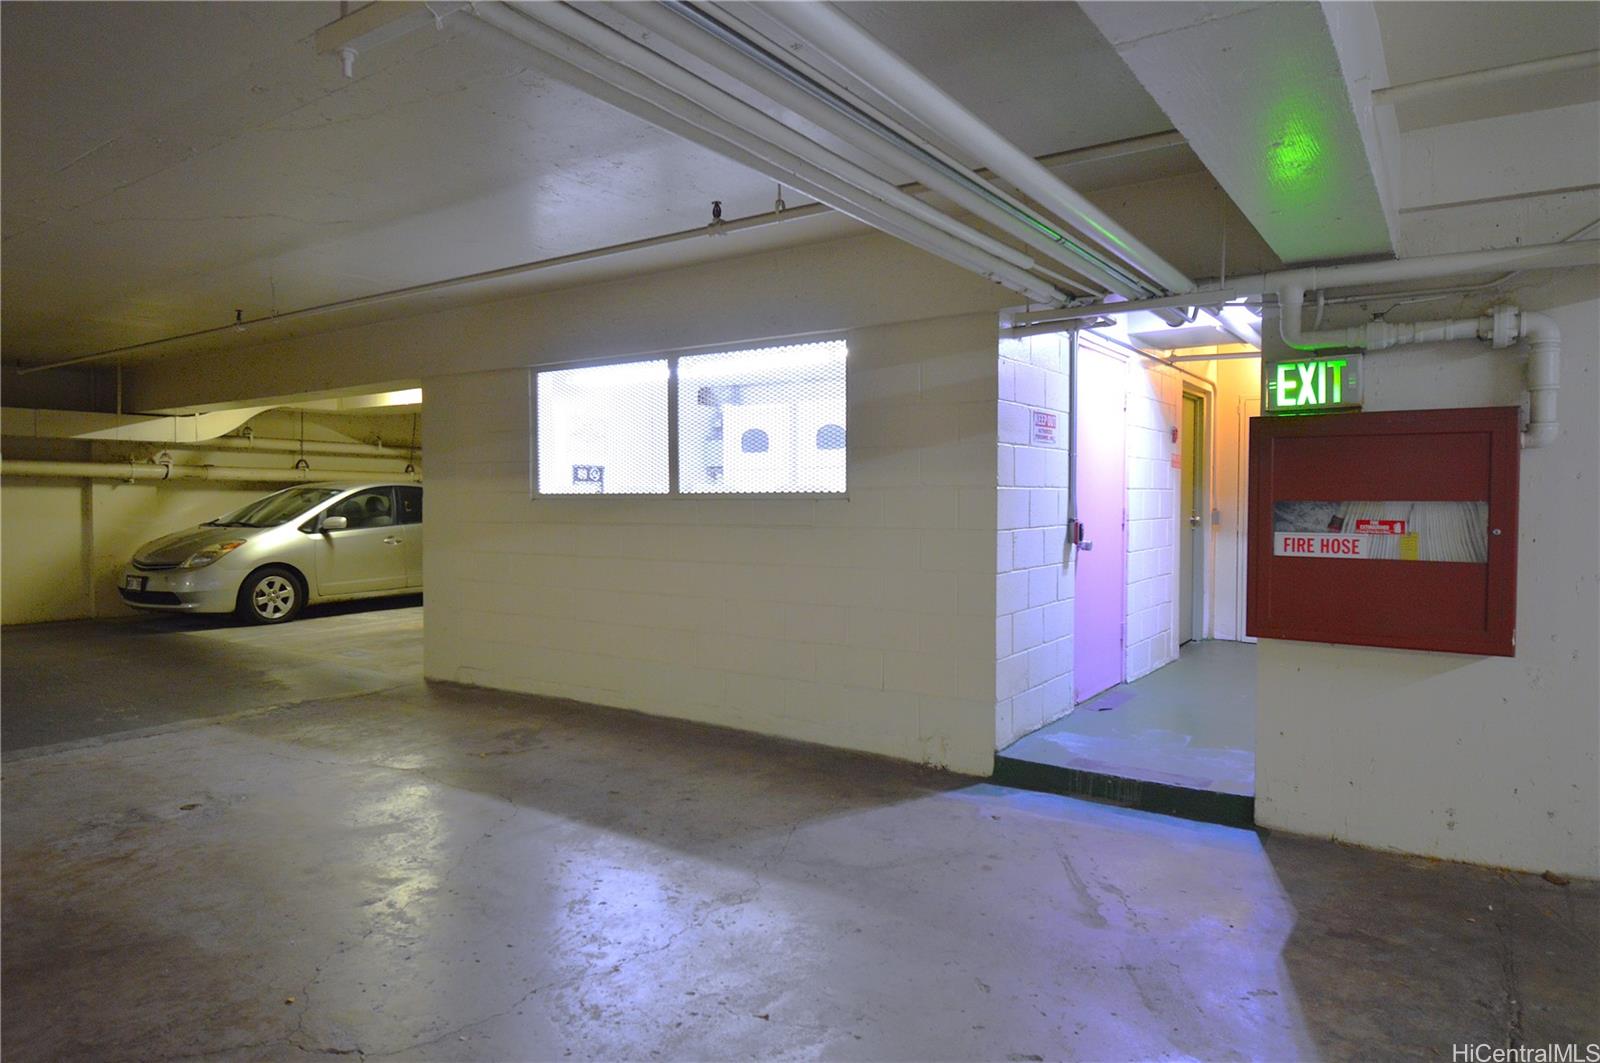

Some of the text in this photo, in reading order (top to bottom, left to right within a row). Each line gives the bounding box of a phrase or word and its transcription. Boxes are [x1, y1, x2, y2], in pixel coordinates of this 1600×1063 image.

[1277, 361, 1347, 406] EXIT
[1283, 537, 1360, 555] FIRE HOSE
